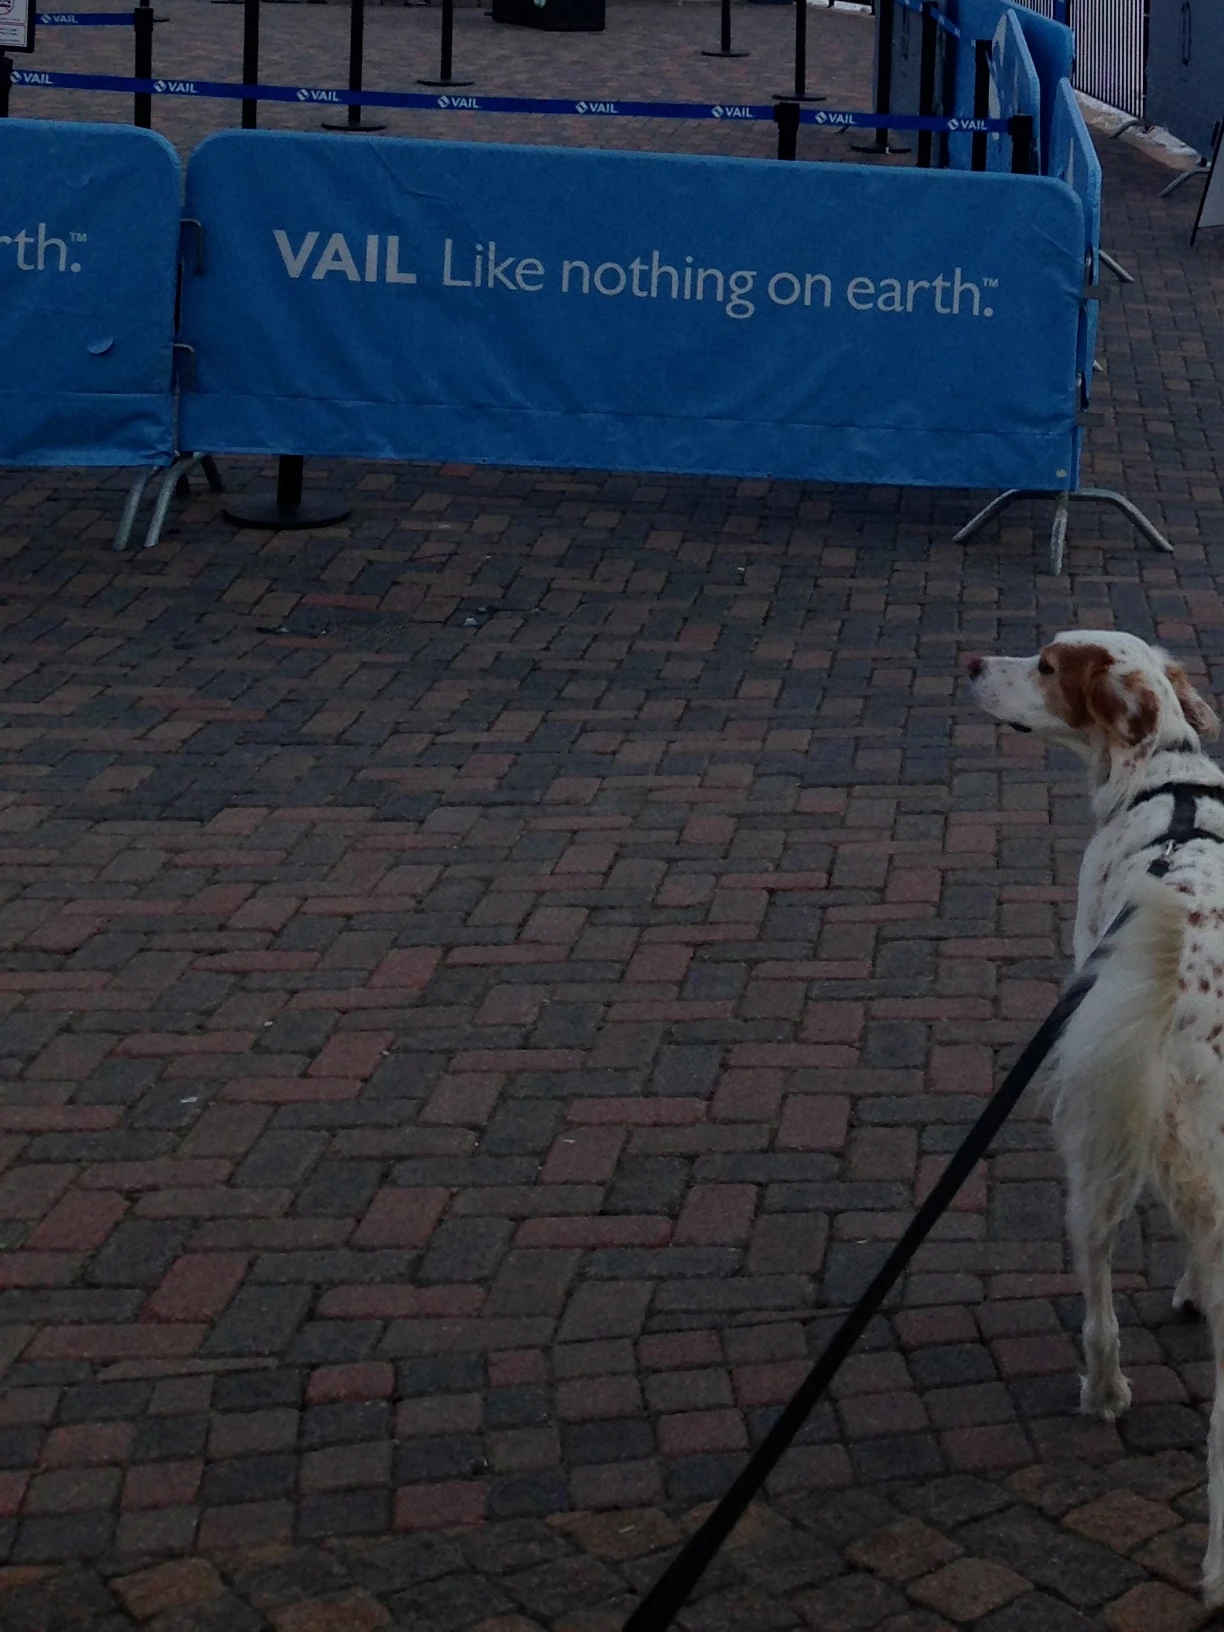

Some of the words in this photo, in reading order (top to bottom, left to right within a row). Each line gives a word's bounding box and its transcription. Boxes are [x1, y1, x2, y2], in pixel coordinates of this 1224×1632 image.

[52, 14, 79, 23] VAIL
[23, 71, 53, 86] VAIL
[167, 80, 197, 94] VAIL
[309, 89, 340, 102] VAIL
[451, 96, 480, 110] VAIL
[588, 102, 618, 115] VAIL
[725, 106, 754, 119] VAIL
[828, 112, 856, 125] VAIL
[960, 119, 988, 131] VAIL
[272, 229, 417, 285] VAIL
[442, 237, 545, 292] Like
[561, 249, 757, 319] nothing
[767, 271, 832, 308] on
